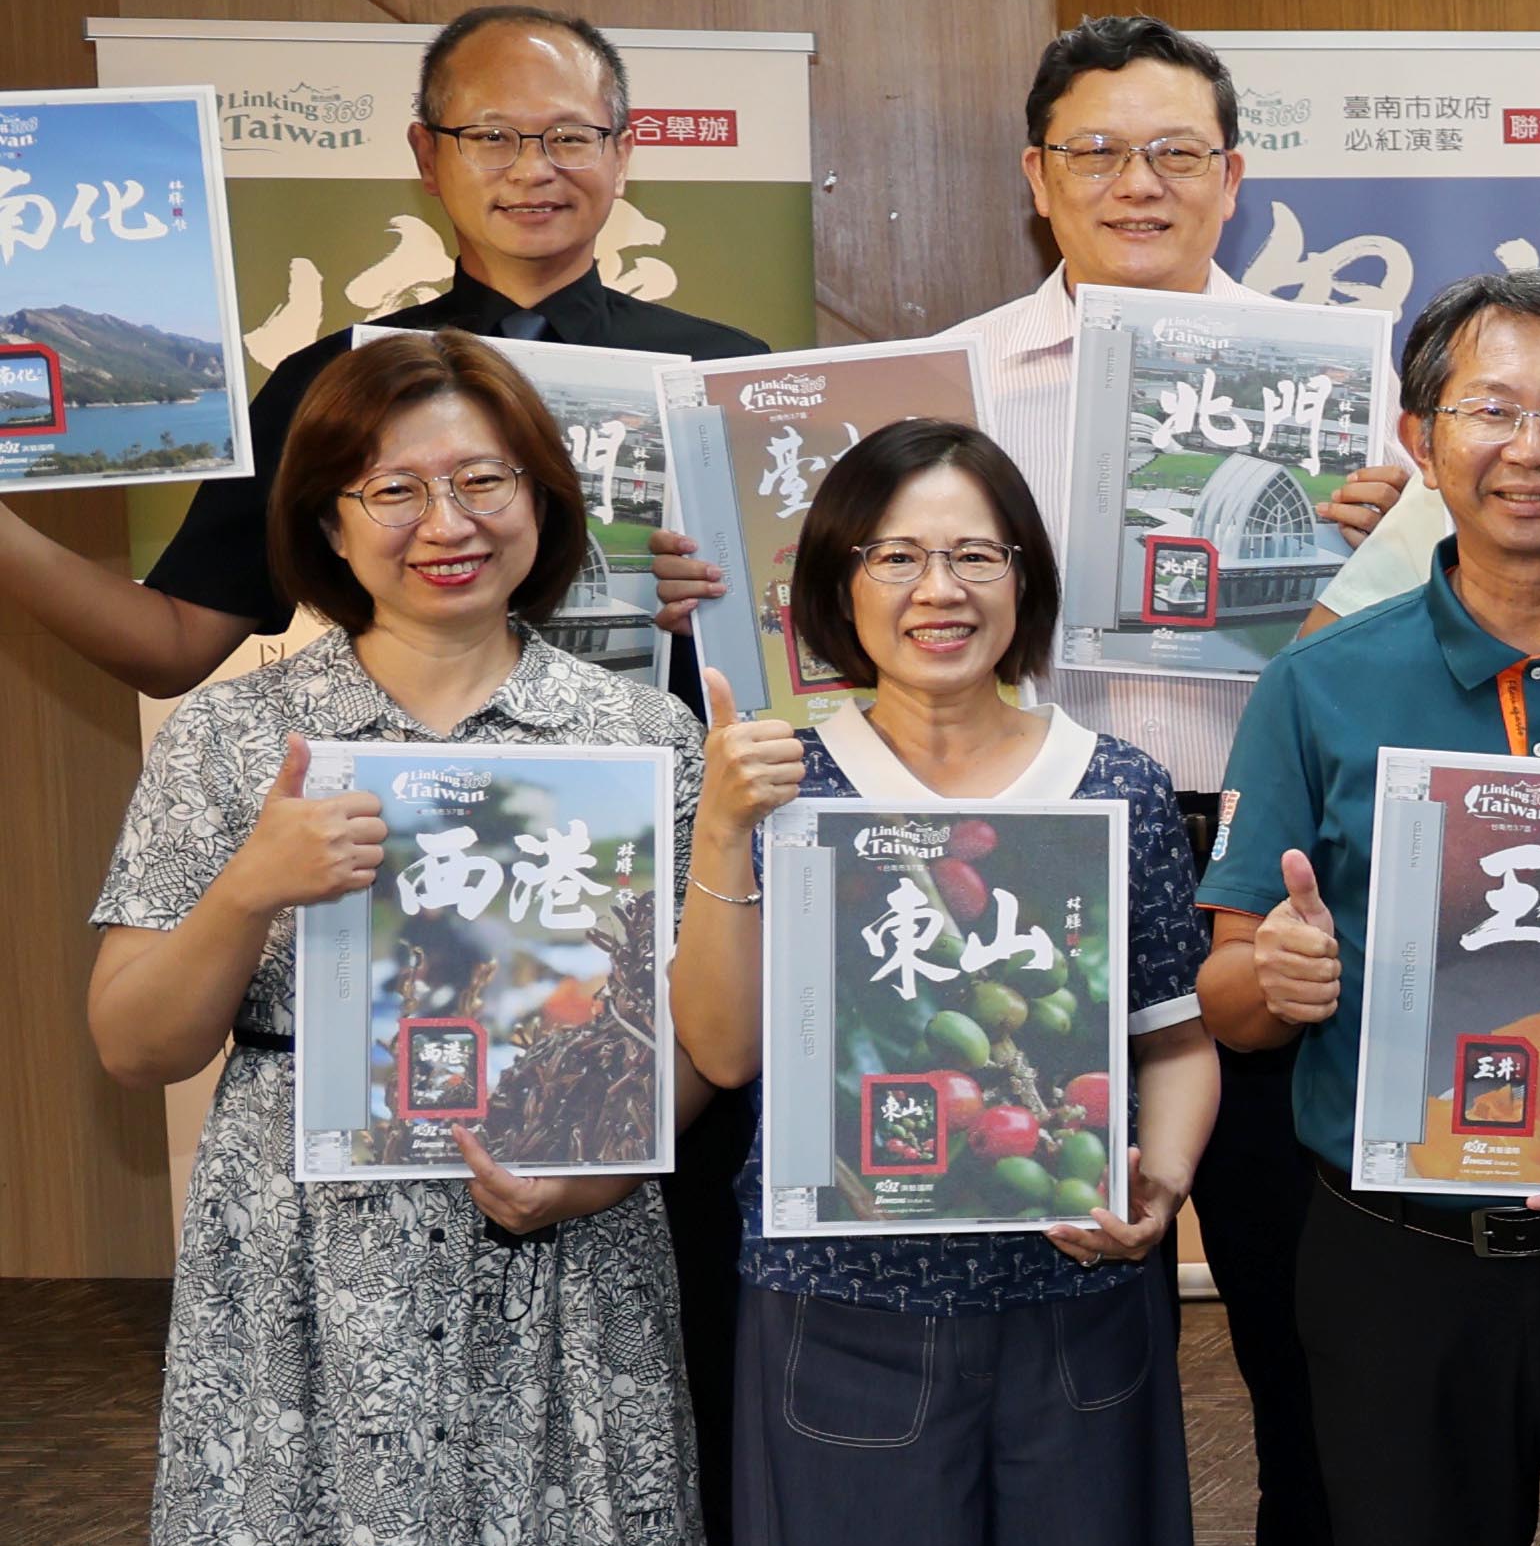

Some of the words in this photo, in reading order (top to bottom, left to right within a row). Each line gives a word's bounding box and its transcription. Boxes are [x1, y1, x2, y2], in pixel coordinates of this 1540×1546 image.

[229, 90, 318, 121] Linking
[322, 94, 374, 124] 368
[1343, 96, 1491, 120] 臺南市政府
[224, 114, 365, 150] Taiwan
[633, 115, 729, 143] 合舉辦
[1238, 129, 1302, 151] wan
[1344, 129, 1463, 151] 必紅演藝
[754, 380, 799, 393] Linking
[753, 391, 822, 407] Taiwan
[1152, 367, 1333, 477] 北門
[411, 769, 460, 787] Linking
[408, 783, 486, 803] Taiwan
[1483, 783, 1529, 803] Linking
[872, 826, 920, 843] Linking
[868, 839, 944, 858] Taiwan
[397, 819, 612, 929] 西港
[861, 877, 1055, 1001] 東山
[1473, 1055, 1516, 1081] 玉井
[881, 1096, 923, 1122] 東山
